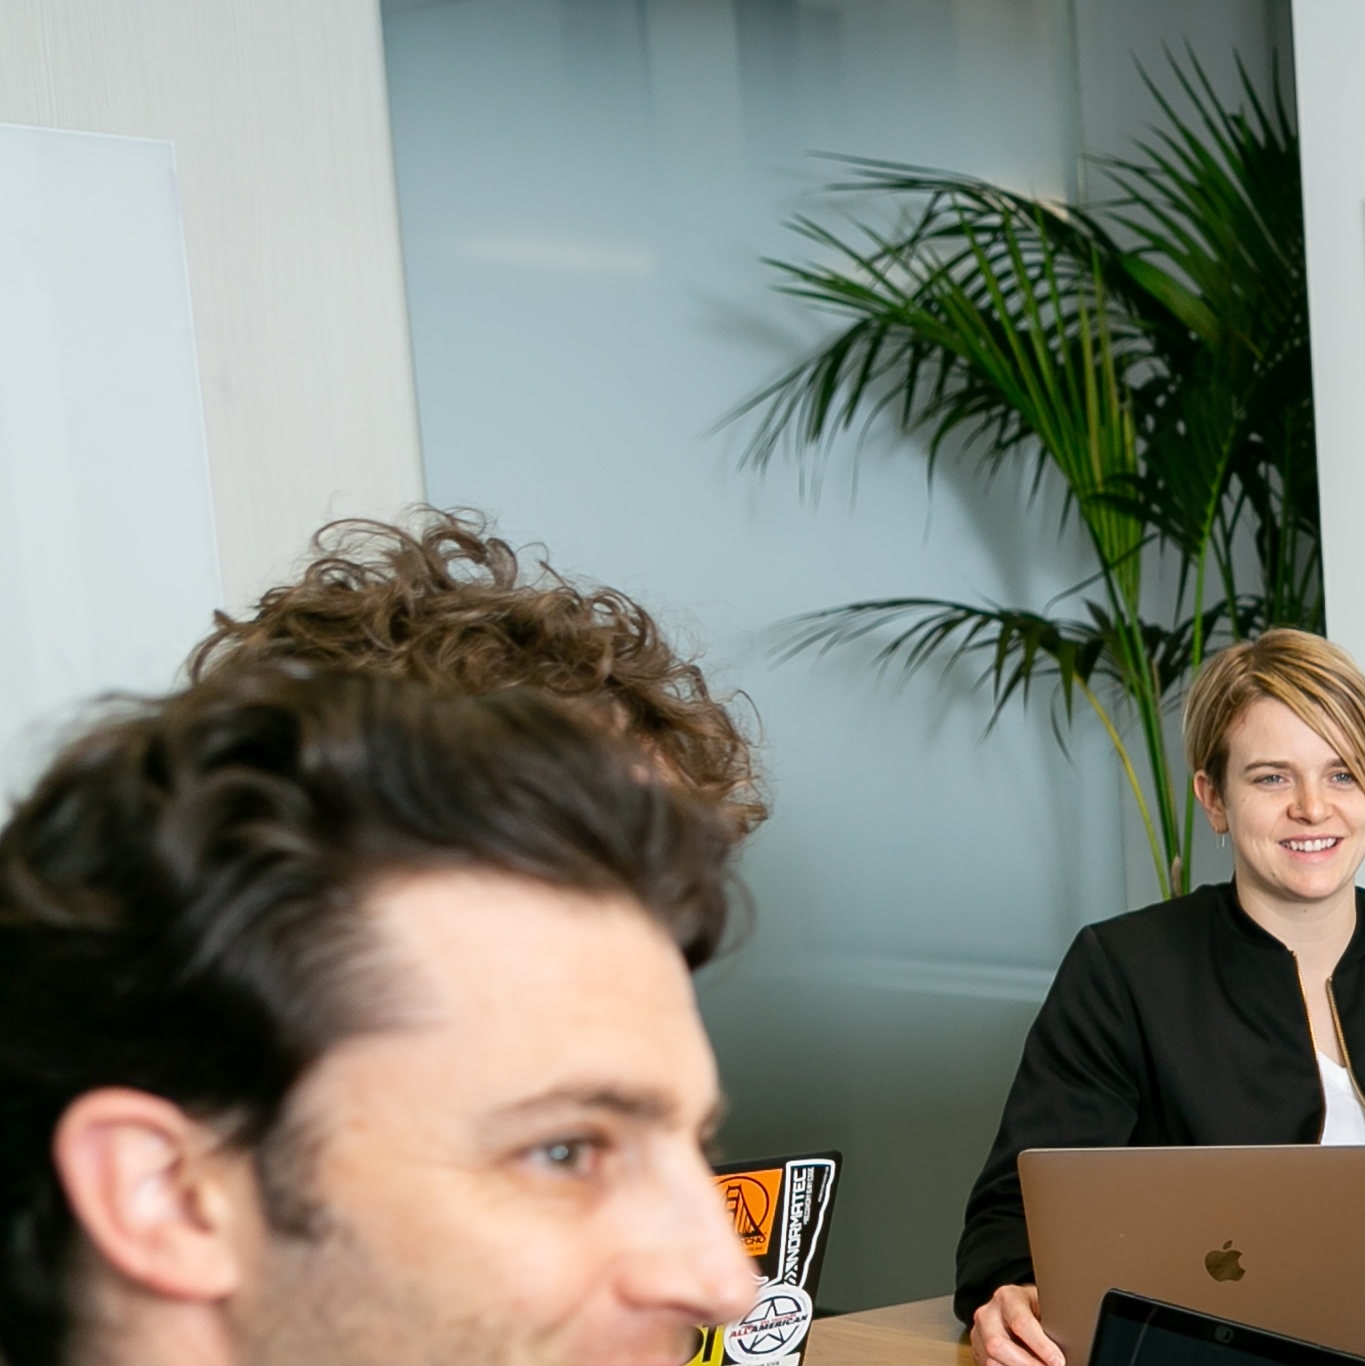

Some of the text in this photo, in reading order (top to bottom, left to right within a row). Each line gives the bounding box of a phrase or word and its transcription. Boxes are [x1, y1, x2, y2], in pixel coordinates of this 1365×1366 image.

[786, 1167, 807, 1264] NORMATEC
[730, 1326, 750, 1338] ALL
[751, 1314, 809, 1333] AMERICAN
